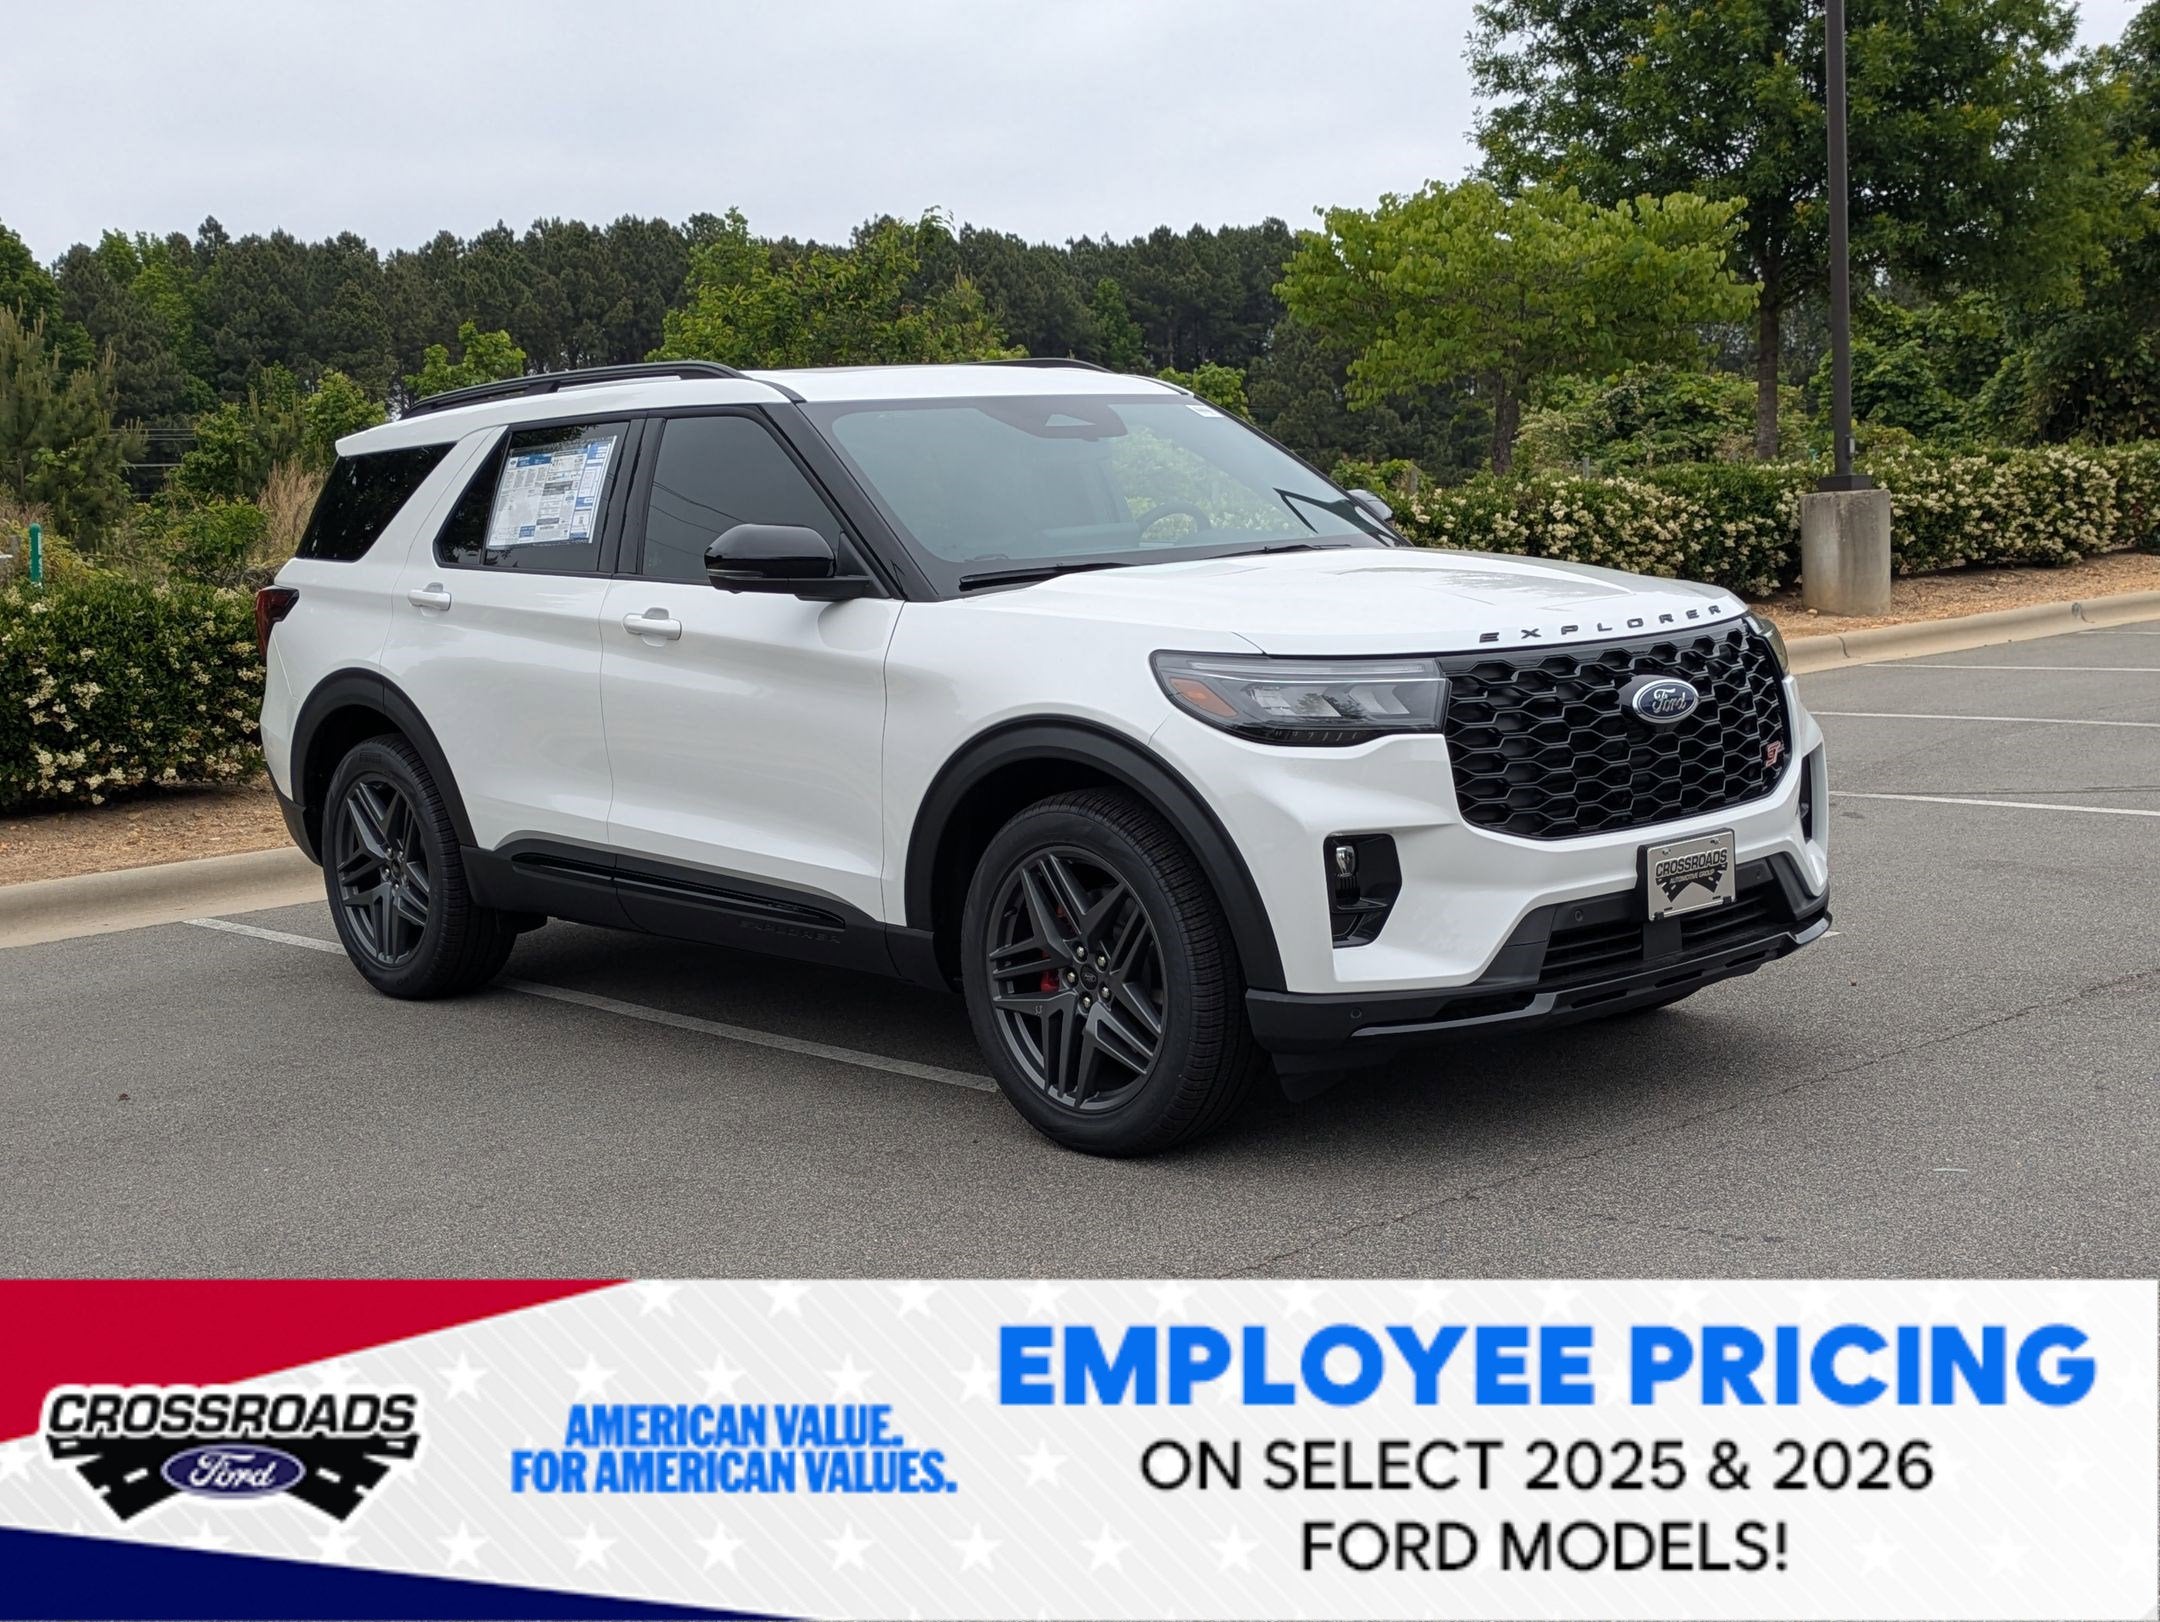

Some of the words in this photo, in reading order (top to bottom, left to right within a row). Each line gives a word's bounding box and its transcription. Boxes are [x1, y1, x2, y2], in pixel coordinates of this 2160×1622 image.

[1479, 605, 1721, 643] EXPLORER
[1652, 688, 1687, 713] Ford
[1655, 849, 1727, 877] CROSSROADS
